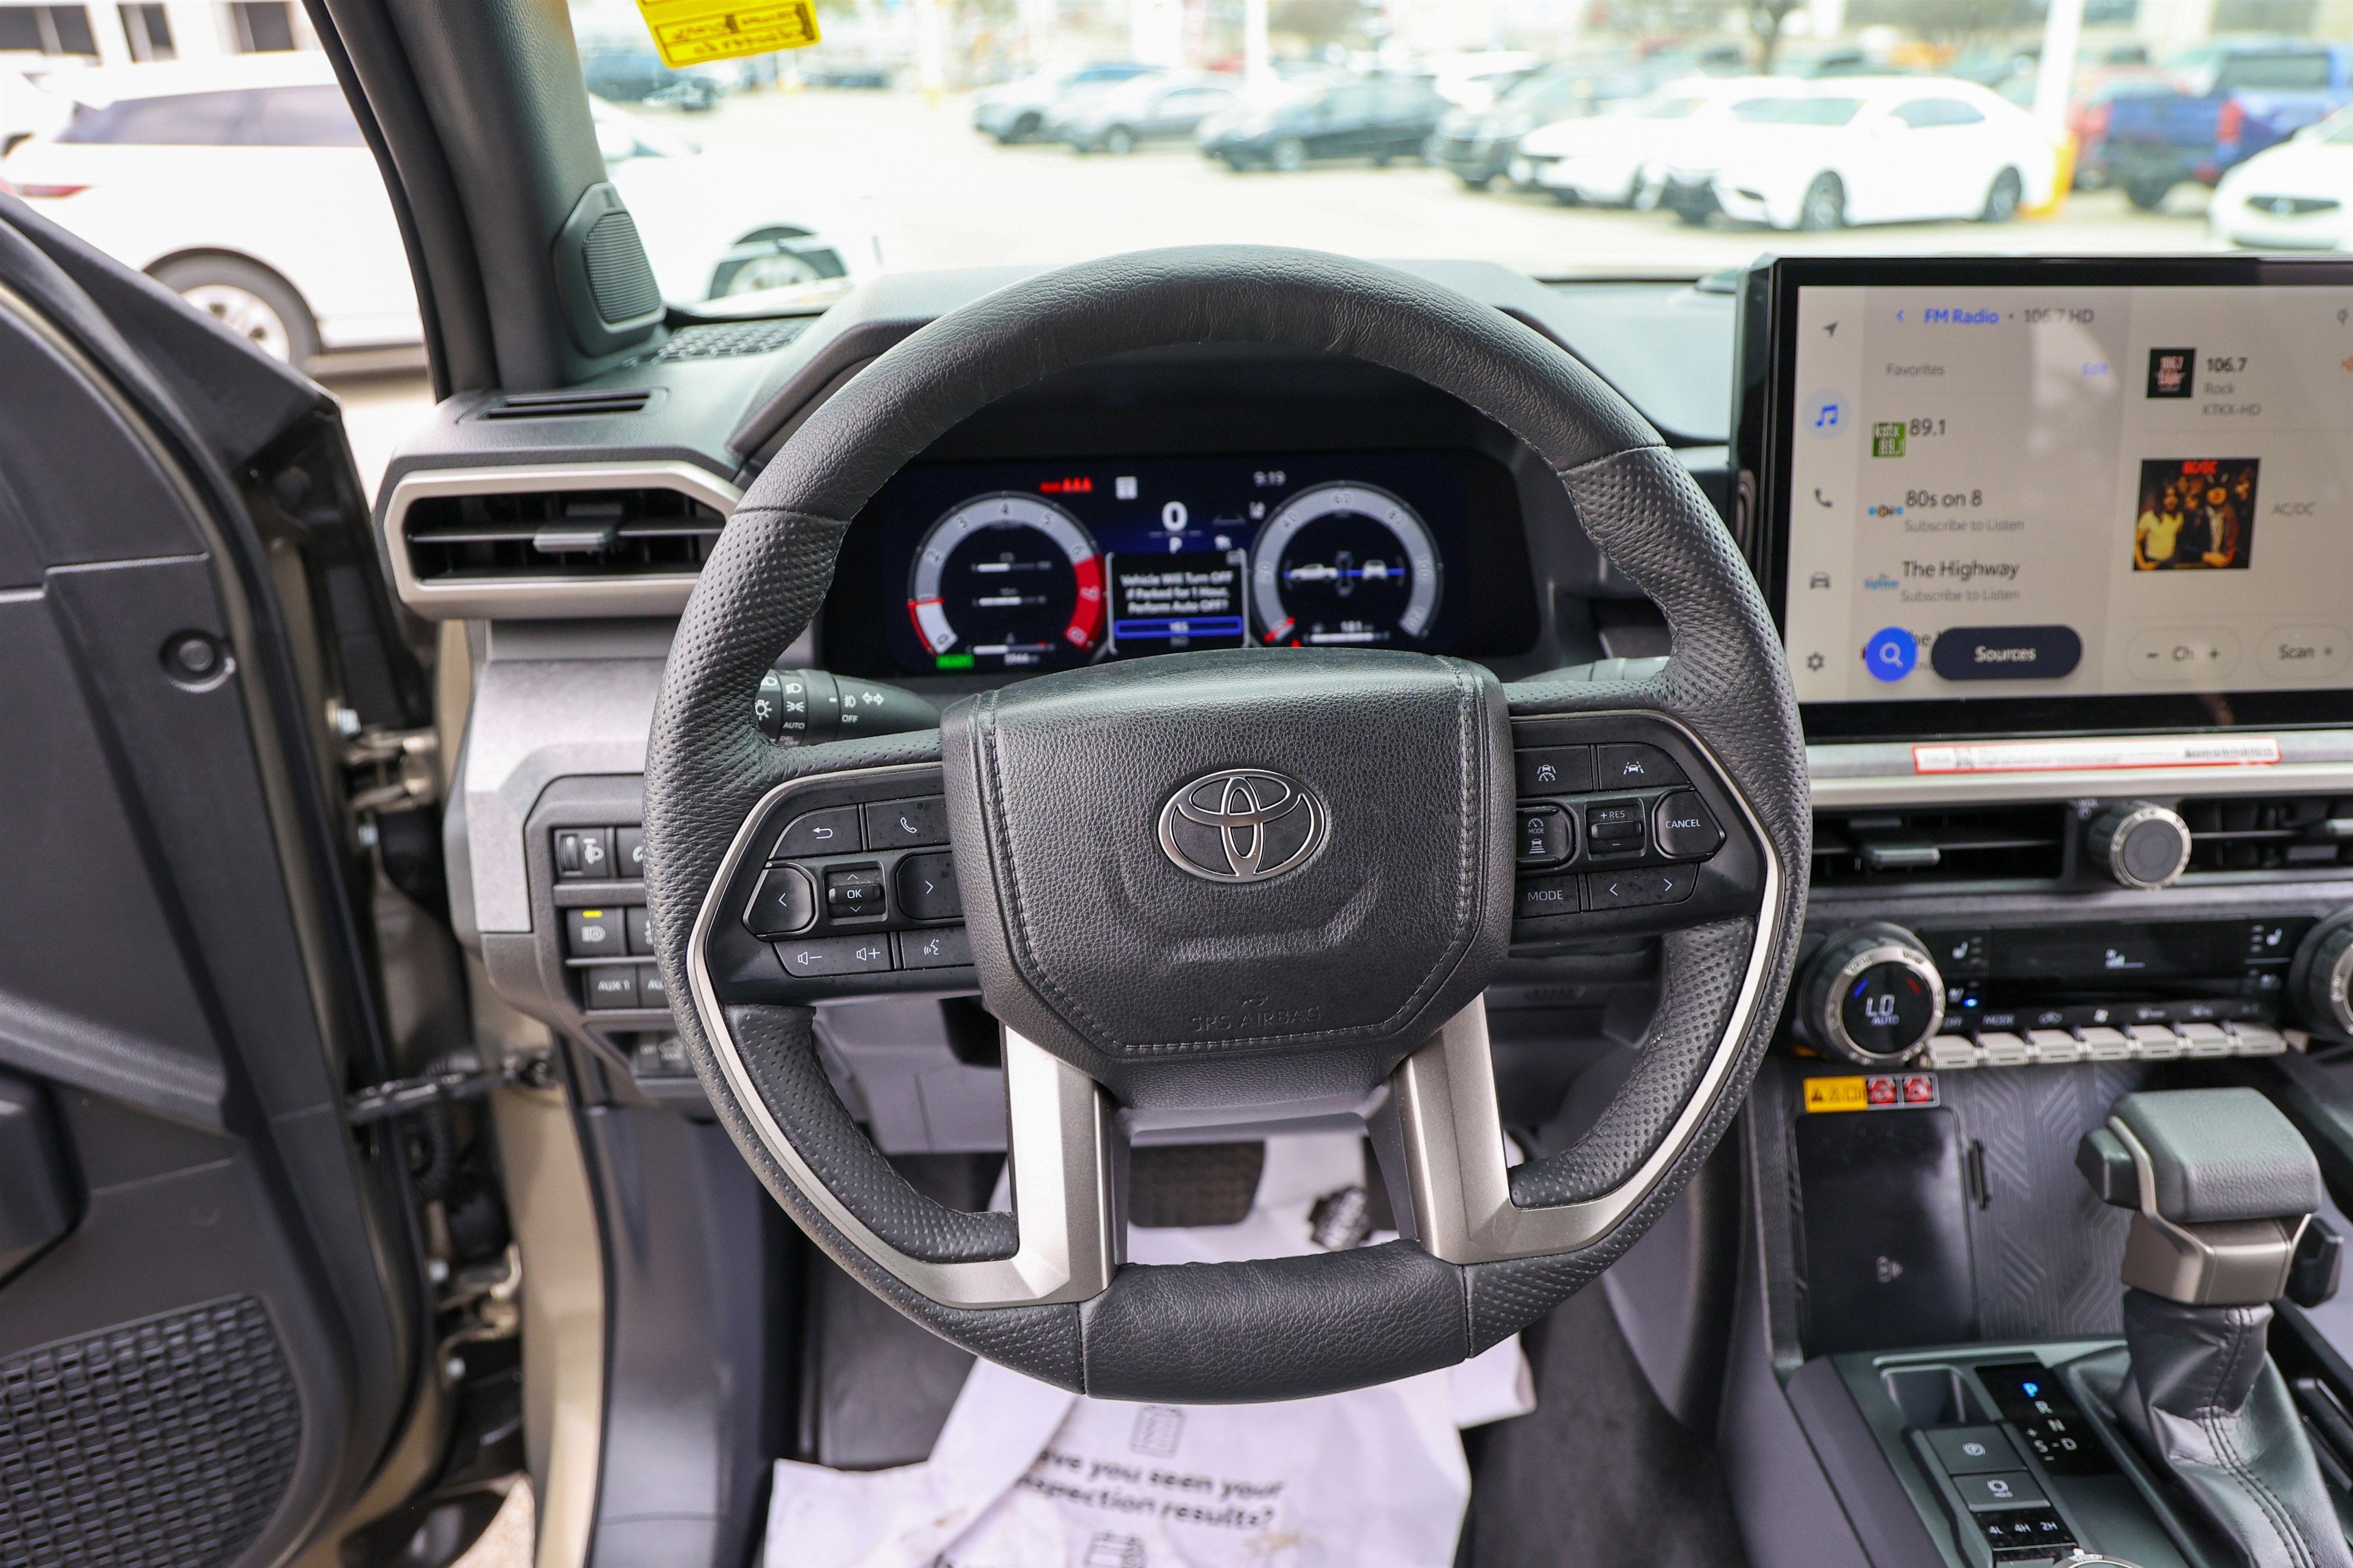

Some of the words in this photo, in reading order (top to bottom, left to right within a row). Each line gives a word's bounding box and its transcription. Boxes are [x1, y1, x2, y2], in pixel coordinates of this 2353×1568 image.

[1924, 308, 1949, 323] FM
[1953, 308, 2000, 324] Radio
[2071, 308, 2095, 323] HD
[1886, 362, 1946, 376] Favorites
[2207, 357, 2248, 373] 106.7
[2205, 381, 2236, 395] Rock
[1909, 419, 1946, 437] 89.1
[1905, 489, 1938, 507] 80s
[1942, 493, 1966, 507] on
[1970, 489, 1983, 507] 8
[1162, 501, 1188, 531] 0
[1905, 519, 1968, 532] Subscribe
[1969, 520, 1985, 531] to
[1987, 519, 2025, 532] Listen
[1901, 560, 1936, 578] The
[1939, 559, 2020, 582] Highway
[1901, 590, 1962, 603] Subscribe
[1966, 590, 1981, 601] to
[1983, 589, 2020, 602] Listen
[1974, 645, 2037, 663] Sources
[2278, 643, 2316, 661] Scan
[782, 721, 805, 729] AUTO
[842, 715, 859, 724] OFF
[1665, 818, 1702, 828] CANCEL
[847, 889, 862, 899] OK
[1527, 890, 1564, 901] MODE
[597, 979, 622, 992] AUX
[623, 979, 630, 991] 1
[647, 979, 666, 991] AU
[1190, 1015, 1232, 1032] SRS
[1239, 1006, 1321, 1028] AIRBAG
[2022, 1382, 2039, 1397] P
[2034, 1400, 2053, 1414] R
[2047, 1419, 2066, 1432] N
[2034, 1439, 2049, 1453] S
[2060, 1437, 2077, 1451] D
[1036, 1449, 1082, 1469] ave
[1089, 1457, 1141, 1483] you
[1148, 1469, 1216, 1491] seen
[1219, 1478, 1287, 1504] your
[1016, 1474, 1155, 1512] nspection
[1160, 1499, 1275, 1530] results?
[1989, 1525, 2004, 1535] 4L
[2013, 1523, 2032, 1533] 4H
[2039, 1521, 2058, 1531] 2H
